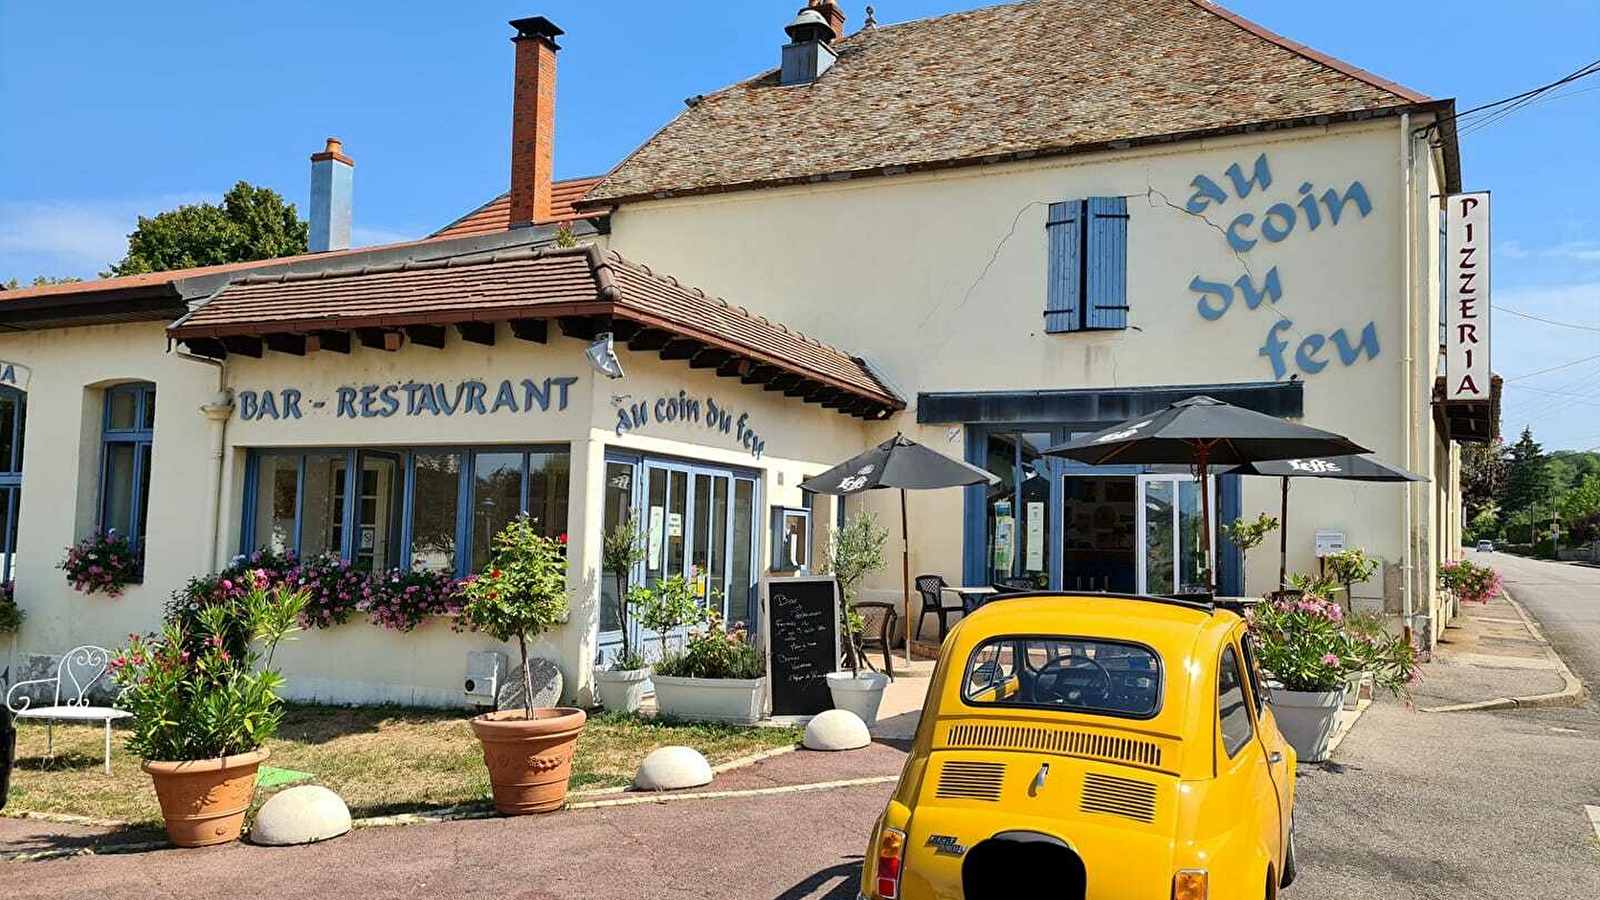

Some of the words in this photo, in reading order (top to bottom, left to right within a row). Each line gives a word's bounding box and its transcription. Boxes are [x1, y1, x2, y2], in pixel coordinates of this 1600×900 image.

[1187, 153, 1273, 213] au
[1226, 181, 1373, 252] coin
[1189, 266, 1283, 322] du
[1456, 197, 1480, 395] PIZZERIA
[0, 364, 17, 384] A
[1259, 320, 1380, 381] feu
[239, 388, 302, 421] BAR
[337, 376, 578, 418] RESTAURANT
[617, 402, 648, 436] au
[655, 390, 700, 424] coin
[706, 397, 733, 433] du
[737, 412, 766, 460] feu
